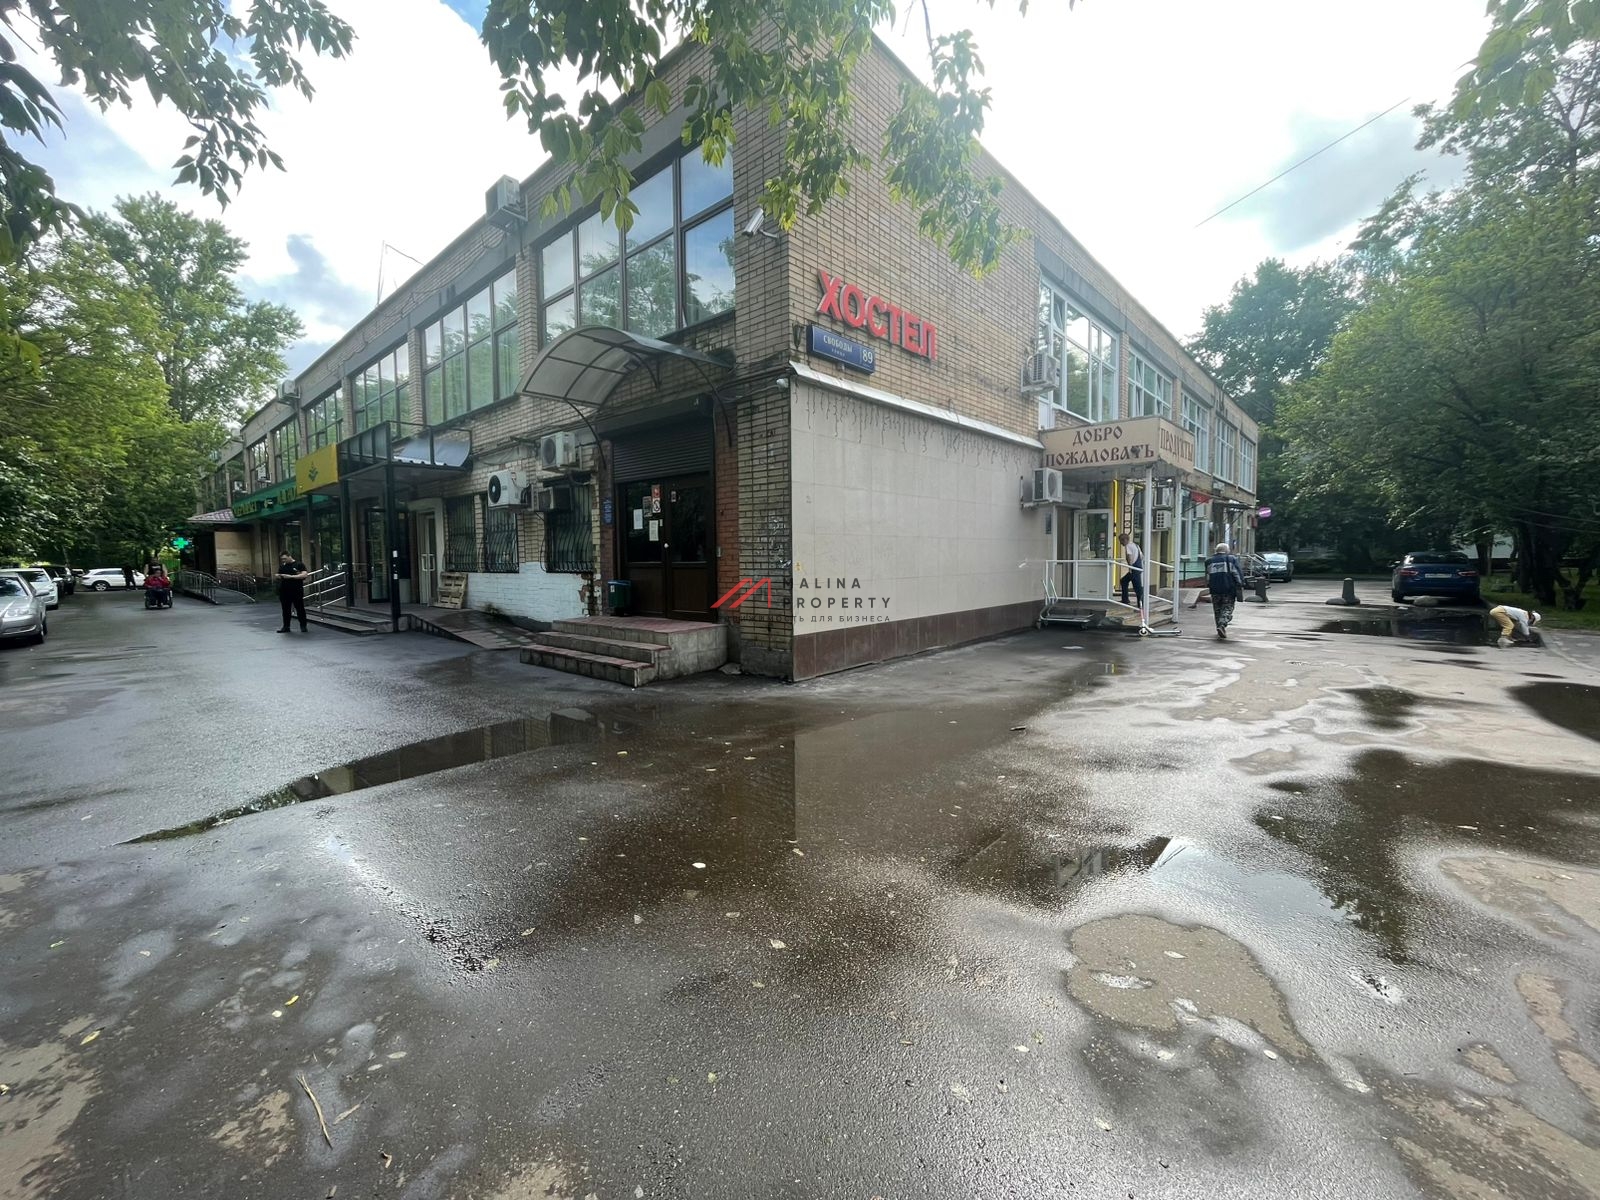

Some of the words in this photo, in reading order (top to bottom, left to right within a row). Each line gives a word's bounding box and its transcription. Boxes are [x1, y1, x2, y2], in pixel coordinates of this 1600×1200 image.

[817, 269, 937, 361] ХОСТЕЛ
[862, 349, 873, 364] 89
[1072, 425, 1123, 447] ДОБРО
[1159, 427, 1193, 463] ПРОДУКТЫ
[1045, 444, 1155, 467] ПОЖАЛОВАТЬ
